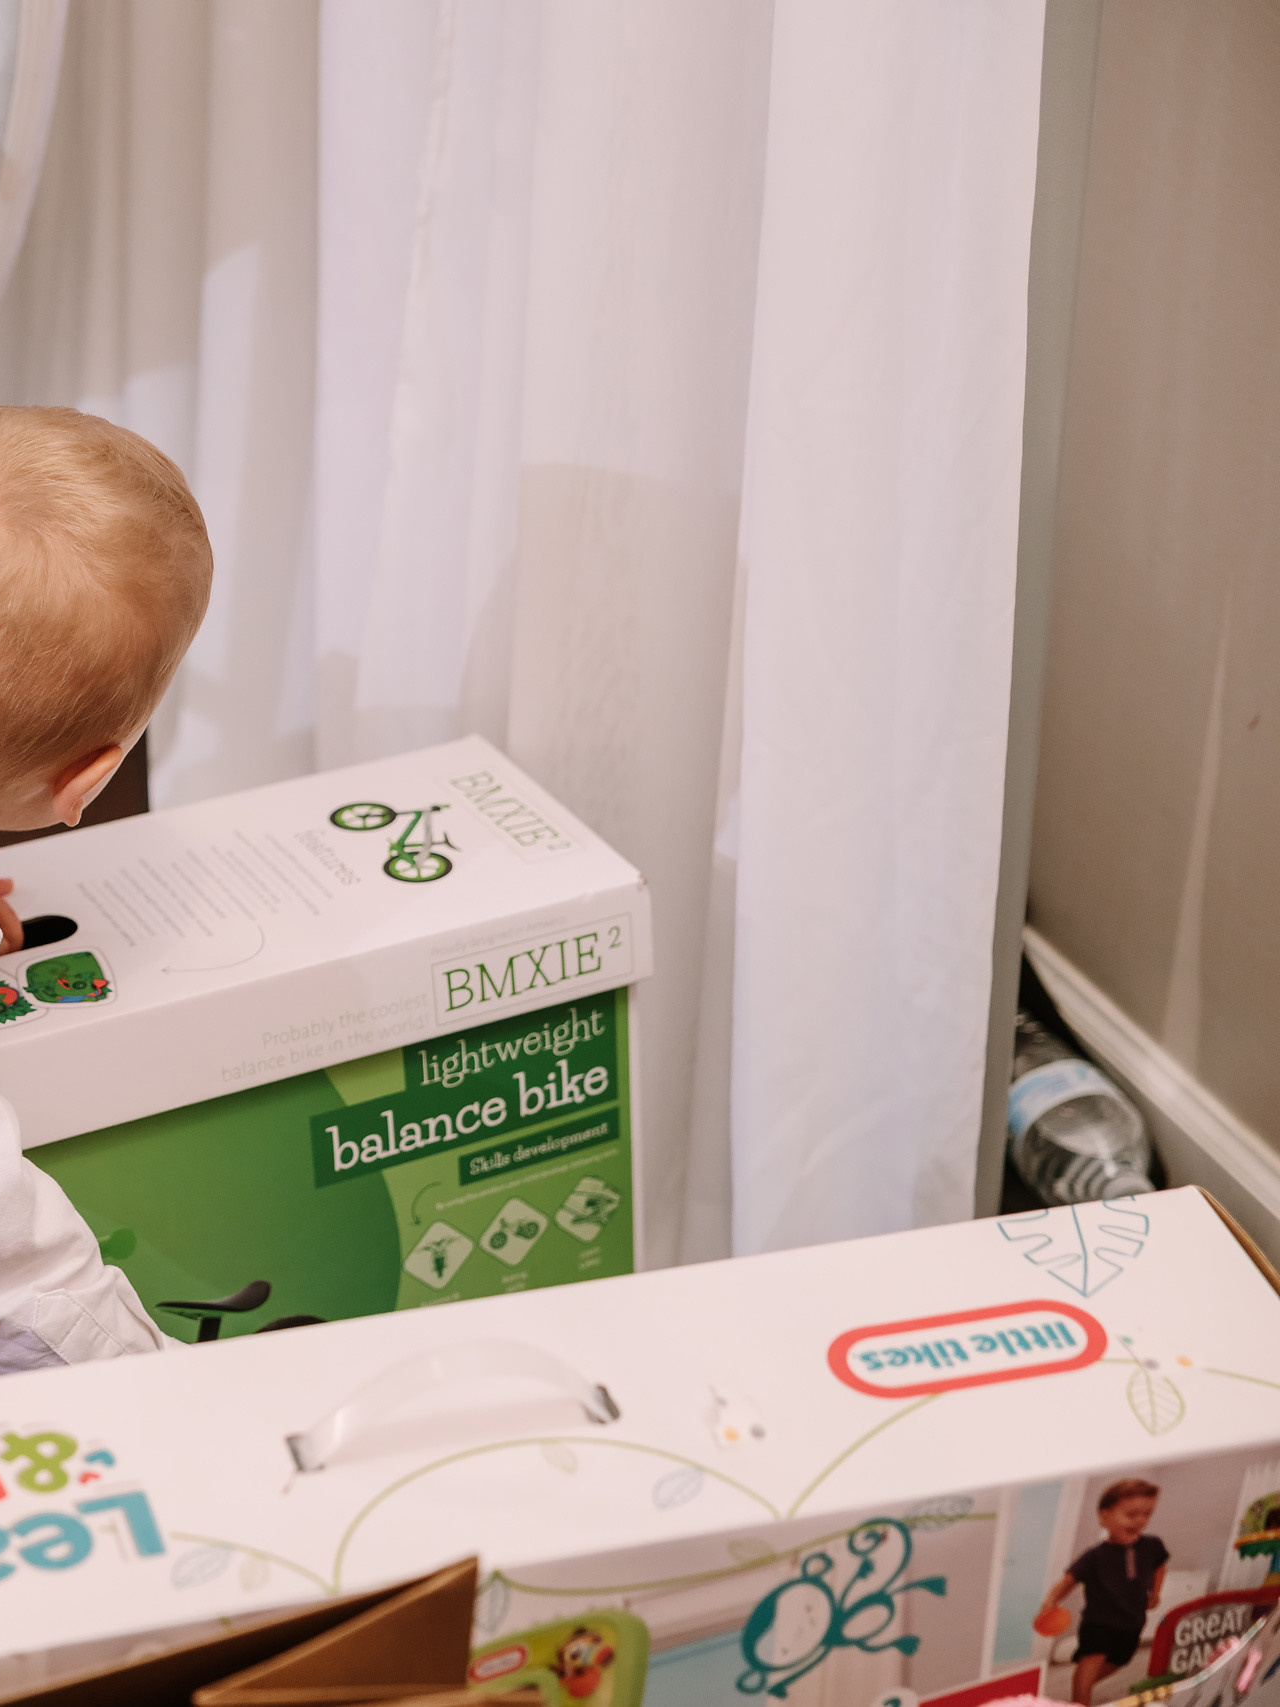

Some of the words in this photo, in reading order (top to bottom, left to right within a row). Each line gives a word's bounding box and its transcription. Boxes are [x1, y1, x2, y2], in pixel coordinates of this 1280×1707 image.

[261, 1016, 335, 1050] Probably
[338, 1008, 367, 1028] the
[369, 993, 429, 1020] coolest
[418, 1007, 606, 1089] lightweight
[220, 1053, 286, 1083] balance
[289, 1043, 325, 1064] bike
[328, 1037, 344, 1052] in
[347, 1030, 375, 1048] the
[325, 1096, 508, 1172] balance
[512, 1059, 609, 1118] bike
[469, 1151, 512, 1176] Skills
[513, 1122, 609, 1163] development
[859, 1339, 969, 1371] tikes
[968, 1321, 1077, 1356] little
